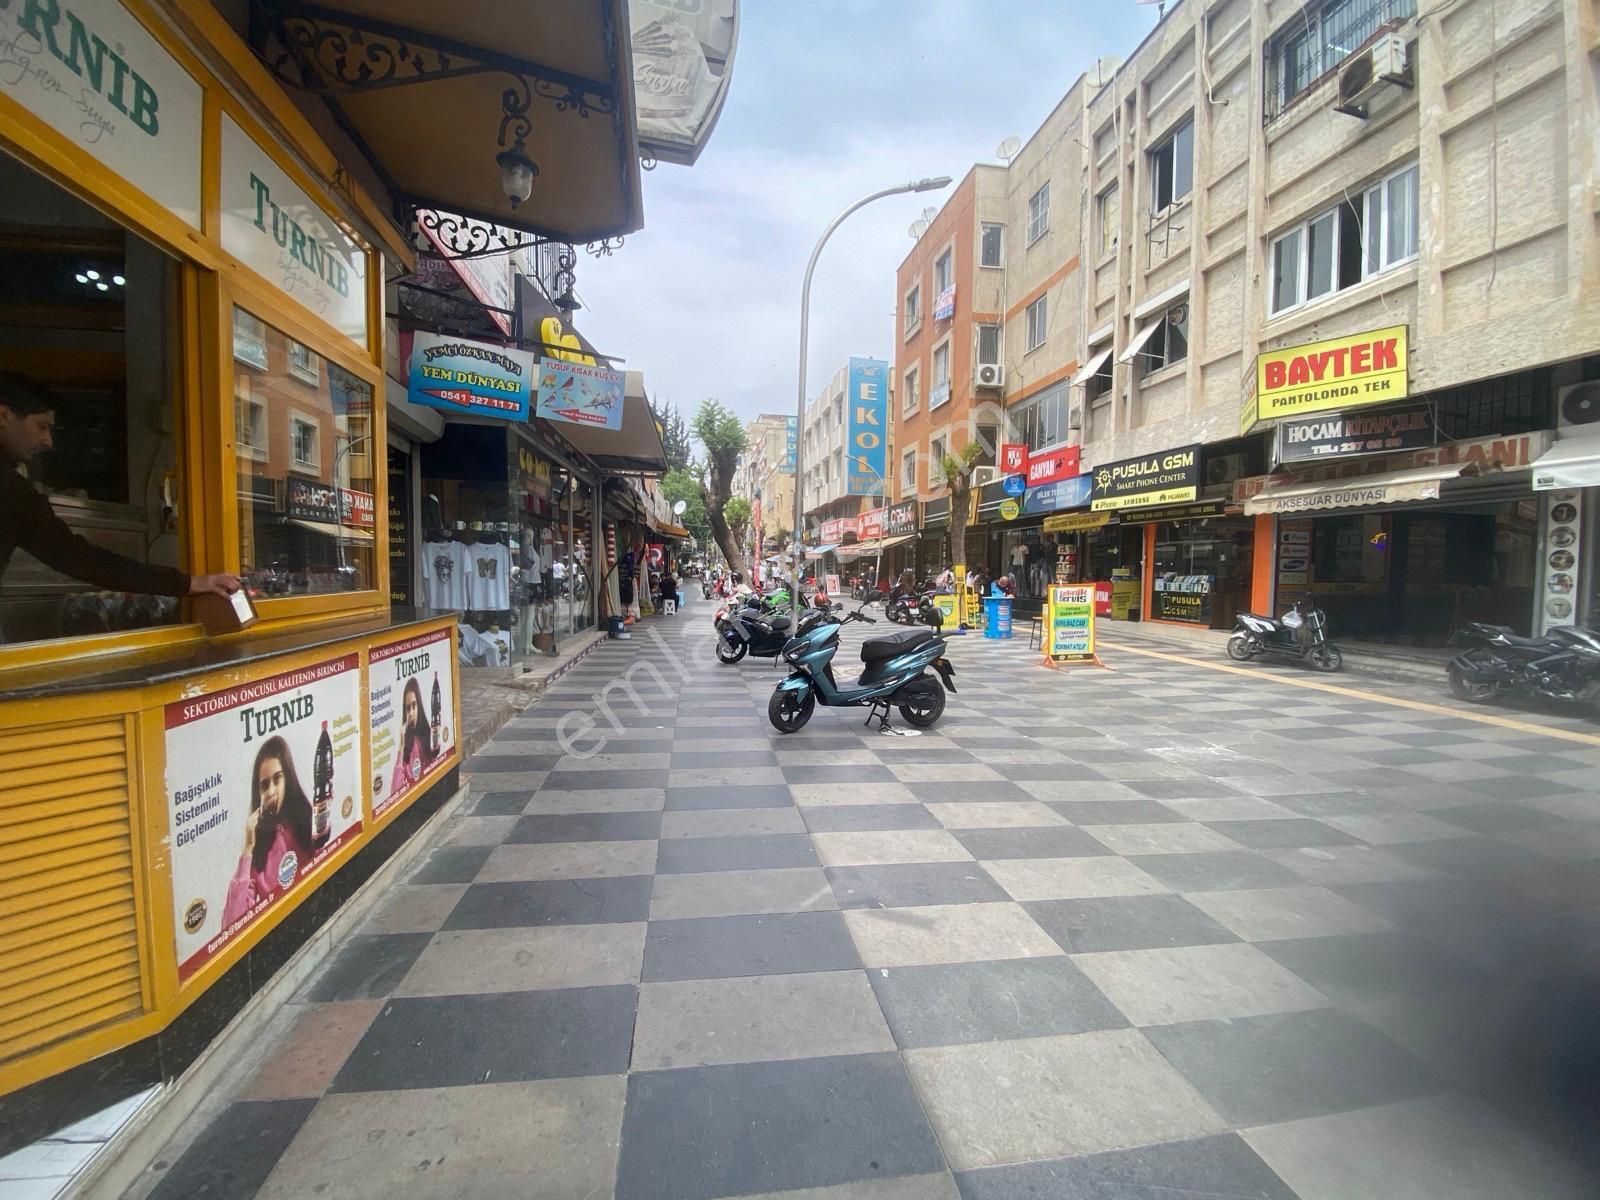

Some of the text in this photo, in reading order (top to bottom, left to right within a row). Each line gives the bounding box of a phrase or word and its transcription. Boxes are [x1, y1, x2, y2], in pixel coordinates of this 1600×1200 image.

[545, 361, 570, 373] YUSUF
[572, 366, 593, 377] KISAK
[1265, 338, 1398, 390] BAYTEK
[422, 366, 521, 393] YEM DÜNYASI
[440, 390, 520, 412] 0541 327 11 71
[1272, 379, 1391, 408] PANTOLONDA TEK
[1288, 421, 1343, 444] HOCAM
[1030, 460, 1055, 480] GANYAN
[1112, 451, 1194, 480] PUSULA GSM
[1116, 472, 1186, 491] SMART PHONE CENTER
[1168, 492, 1191, 500] HUAWEI
[1276, 489, 1386, 509] AKSESUAR DÜNYASI
[1171, 596, 1201, 606] PUSULA
[1171, 608, 1188, 616] GSM
[184, 692, 238, 720] SEKTÖRÜN
[278, 671, 316, 690] KALİTENİN
[316, 660, 345, 678] BİRİNCİSİ
[174, 772, 222, 806] Bağışıklık
[175, 792, 220, 827] Sistemini
[176, 809, 229, 848] Güçlendirir
[207, 893, 275, 954] turnib@turnib.com.tr
